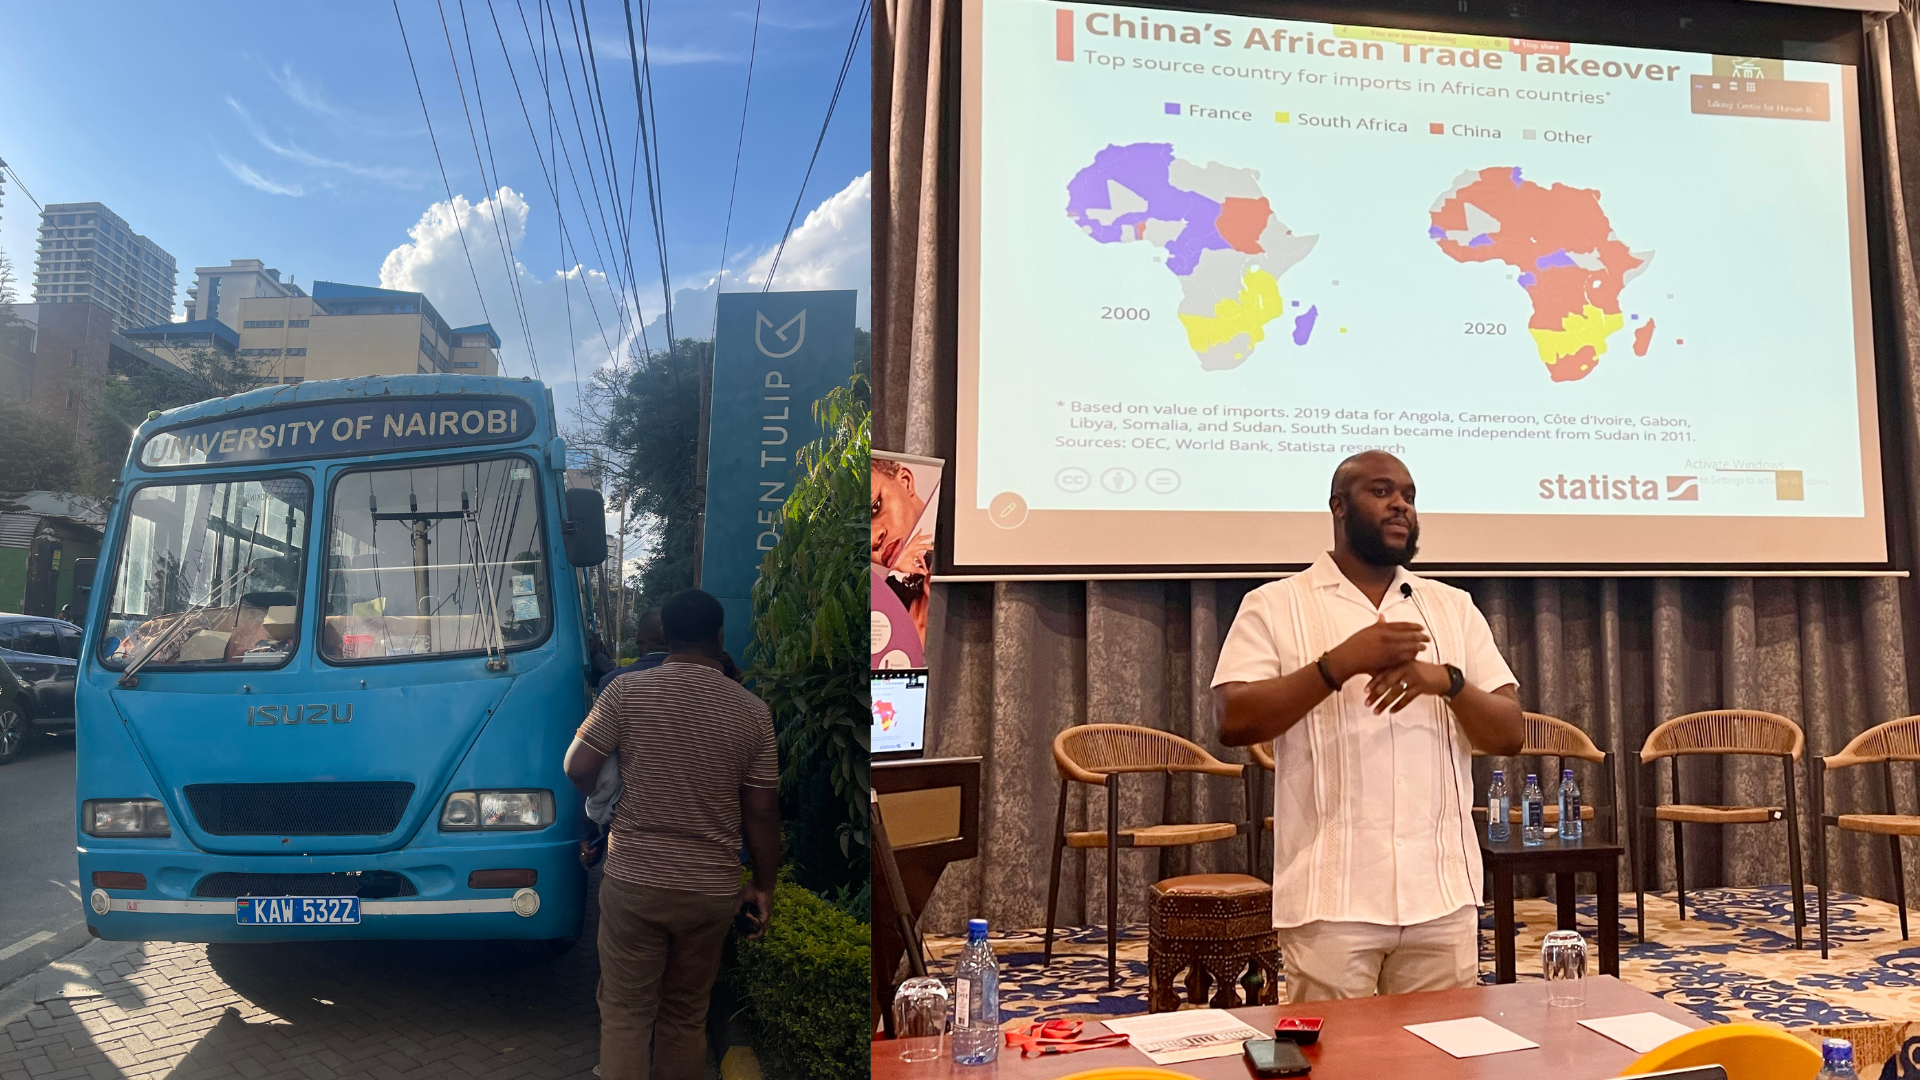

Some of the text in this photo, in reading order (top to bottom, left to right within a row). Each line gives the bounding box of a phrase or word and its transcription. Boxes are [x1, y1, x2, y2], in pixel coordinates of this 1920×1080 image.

[1085, 12, 1681, 82] China's African Trade Takeover
[1522, 41, 1560, 51] Stop share
[1084, 50, 1125, 70] Top
[1133, 58, 1204, 74] source
[1212, 66, 1292, 85] country
[1298, 69, 1327, 84] for
[1334, 72, 1411, 91] imports
[1419, 79, 1435, 92] in
[1441, 81, 1509, 98] African
[1190, 105, 1252, 121] France
[1298, 113, 1408, 133] South Africa
[1451, 124, 1502, 139] China
[1543, 130, 1593, 145] Other
[1100, 306, 1151, 321] 2000
[1464, 322, 1507, 336] 2020
[760, 369, 791, 468] TULIP
[1072, 402, 1121, 413] Based
[1127, 405, 1148, 413] on
[1154, 404, 1197, 415] value
[1203, 405, 1219, 415] of
[1223, 406, 1289, 419] imports.
[1294, 408, 1331, 419] 2019
[1335, 409, 1368, 419] data
[1374, 409, 1396, 421] for
[1399, 410, 1455, 424] Angola,
[1458, 412, 1540, 426] Cameroon,
[1544, 413, 1577, 425] Côte
[1640, 416, 1691, 429] Gabon,
[149, 408, 517, 463] UNIVERSITY OF NAIROBI
[1071, 417, 1695, 441] Libya, Somalia, and Sudan. South Sudan became independent from Sudan in 2011.
[1056, 436, 1125, 448] Sources:
[1132, 438, 1170, 450] OEC,
[1176, 439, 1224, 450] World
[1230, 440, 1272, 452] Bank,
[1278, 441, 1335, 452] Statista
[1684, 459, 1785, 470] Activate Windows
[1538, 474, 1659, 500] statista
[1711, 475, 1743, 486] Settings
[247, 703, 354, 727] ISUZU
[254, 899, 355, 923] KAW 532Z
